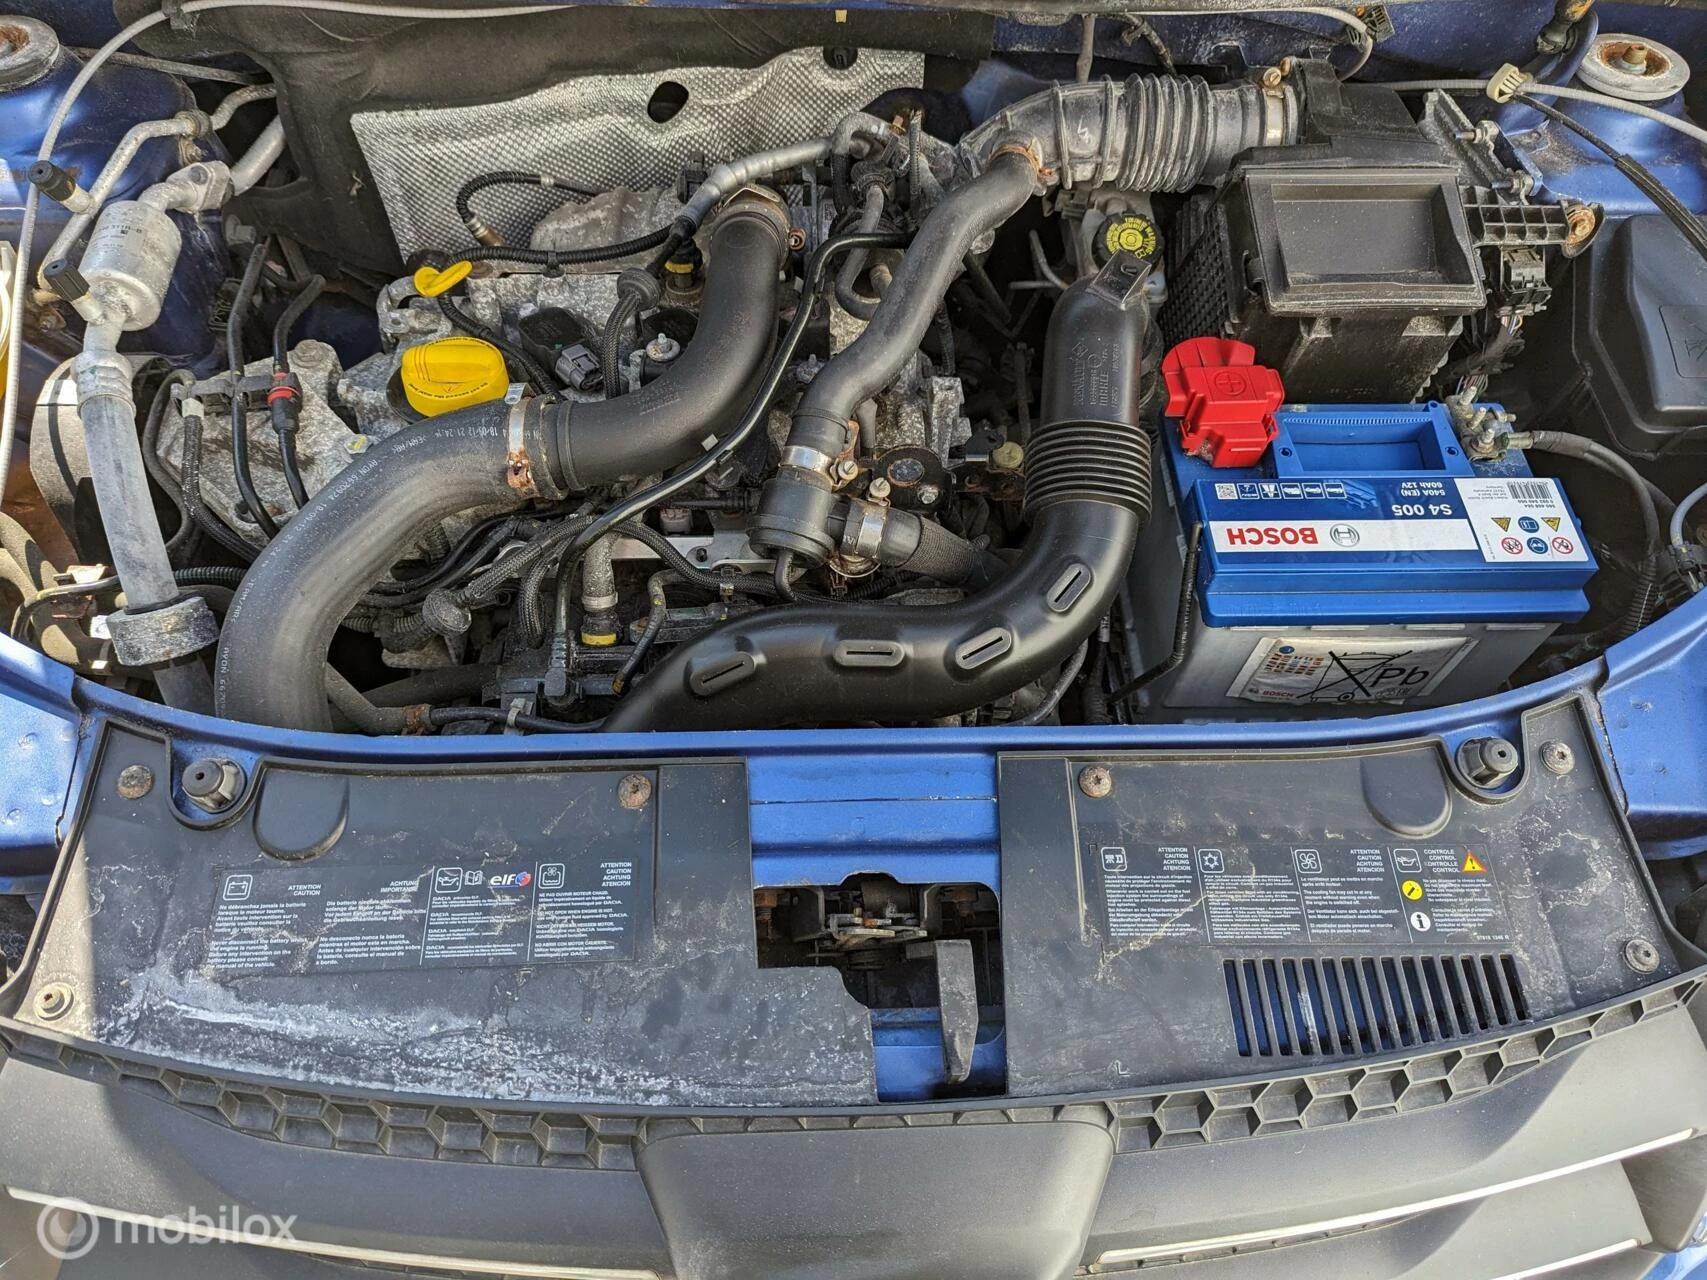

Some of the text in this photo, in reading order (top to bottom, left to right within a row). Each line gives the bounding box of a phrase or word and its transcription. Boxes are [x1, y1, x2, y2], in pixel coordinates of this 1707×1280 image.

[1401, 481, 1443, 489] 60Ah 12V
[1400, 488, 1421, 497] (EN)
[1391, 503, 1453, 516] S4 005
[1226, 527, 1319, 545] BOSCH
[1370, 666, 1429, 687] Pb
[490, 873, 516, 885] elf
